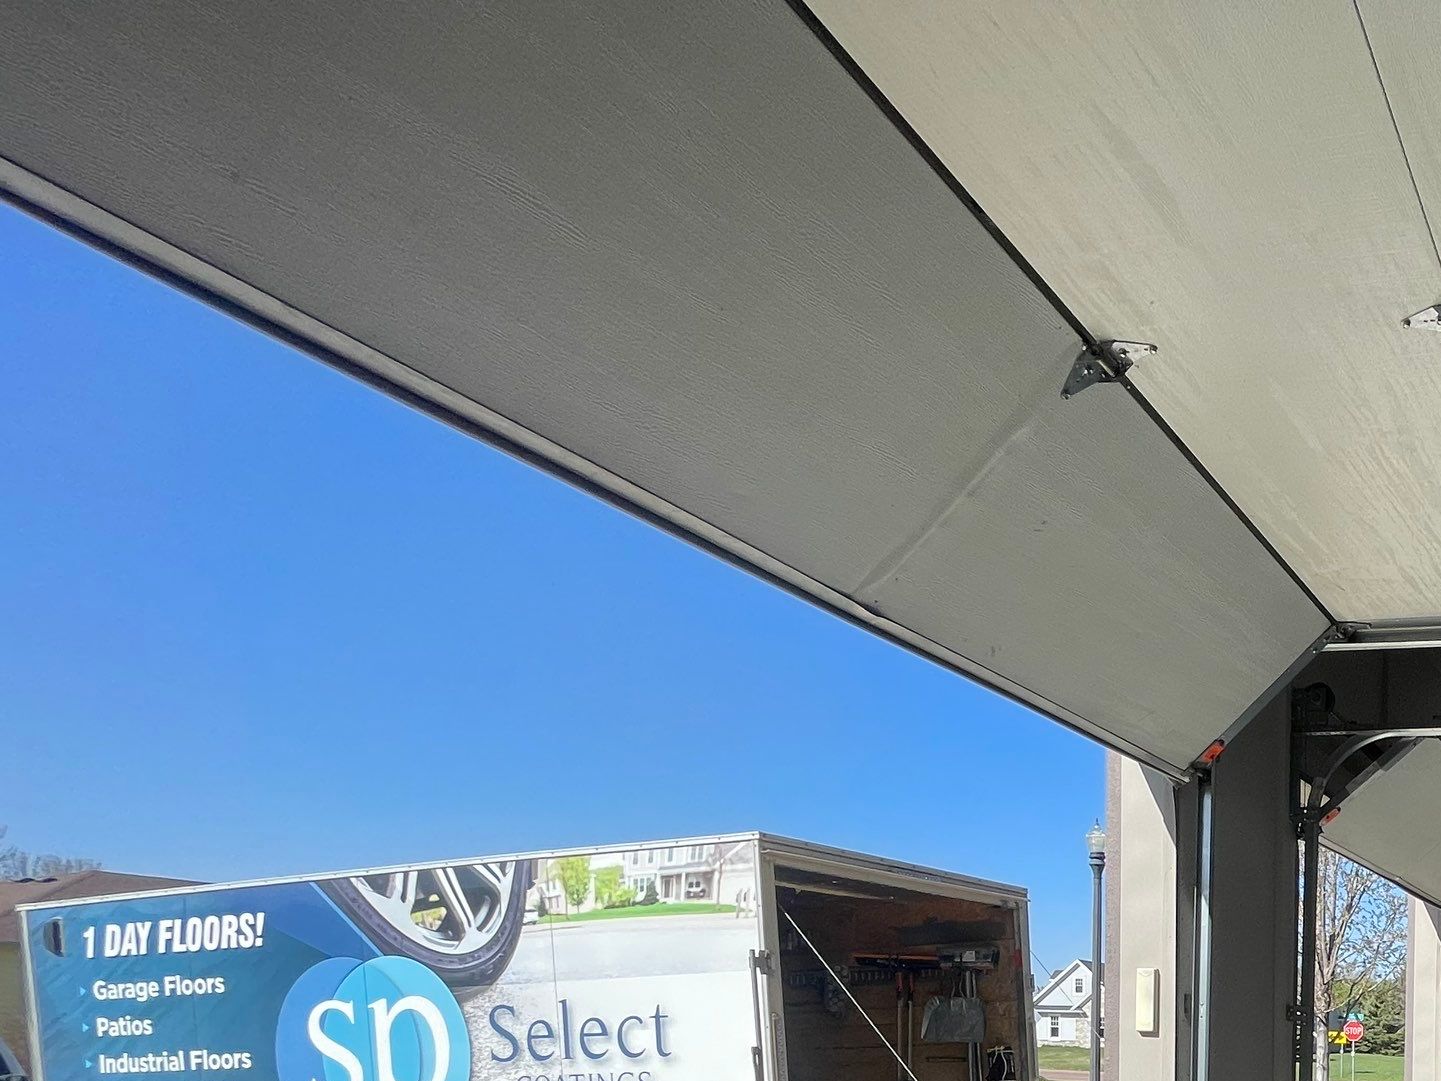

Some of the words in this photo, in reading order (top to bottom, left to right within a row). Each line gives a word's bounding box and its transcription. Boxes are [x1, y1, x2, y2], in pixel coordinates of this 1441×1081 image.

[82, 925, 96, 958] 1
[104, 920, 152, 957] DAY
[158, 911, 266, 953] FLOORS!
[92, 979, 160, 1002] Garage
[163, 974, 226, 996] Floors
[95, 1014, 154, 1037] Patios
[488, 998, 672, 1064] Select
[1345, 1026, 1362, 1035] STOP
[99, 1050, 186, 1074] Industrial
[189, 1049, 252, 1071] Floors
